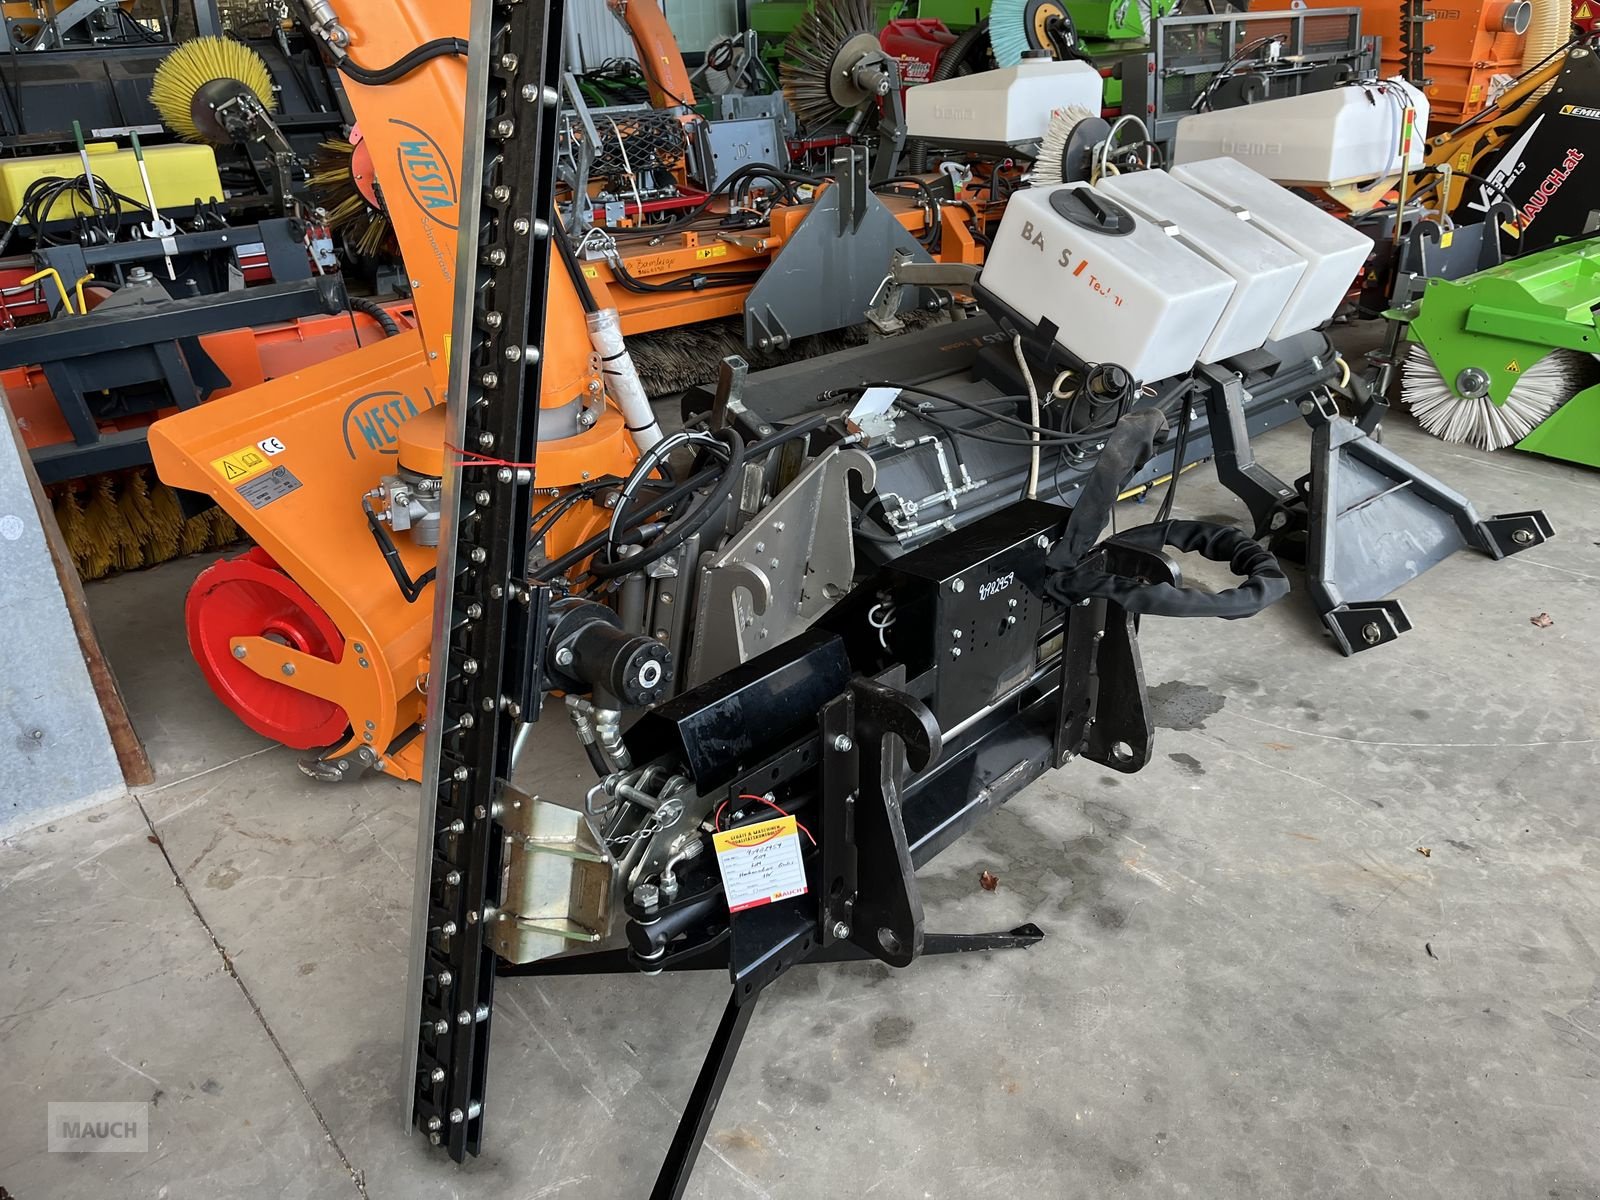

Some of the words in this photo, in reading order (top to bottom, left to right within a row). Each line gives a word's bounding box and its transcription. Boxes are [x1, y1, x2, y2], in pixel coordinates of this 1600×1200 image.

[1220, 137, 1282, 154] bema
[399, 141, 454, 209] WESTA
[1511, 148, 1584, 231] MAUCH.at
[353, 396, 420, 451] WESTA
[261, 438, 284, 454] CE
[775, 887, 802, 899] MAUCH
